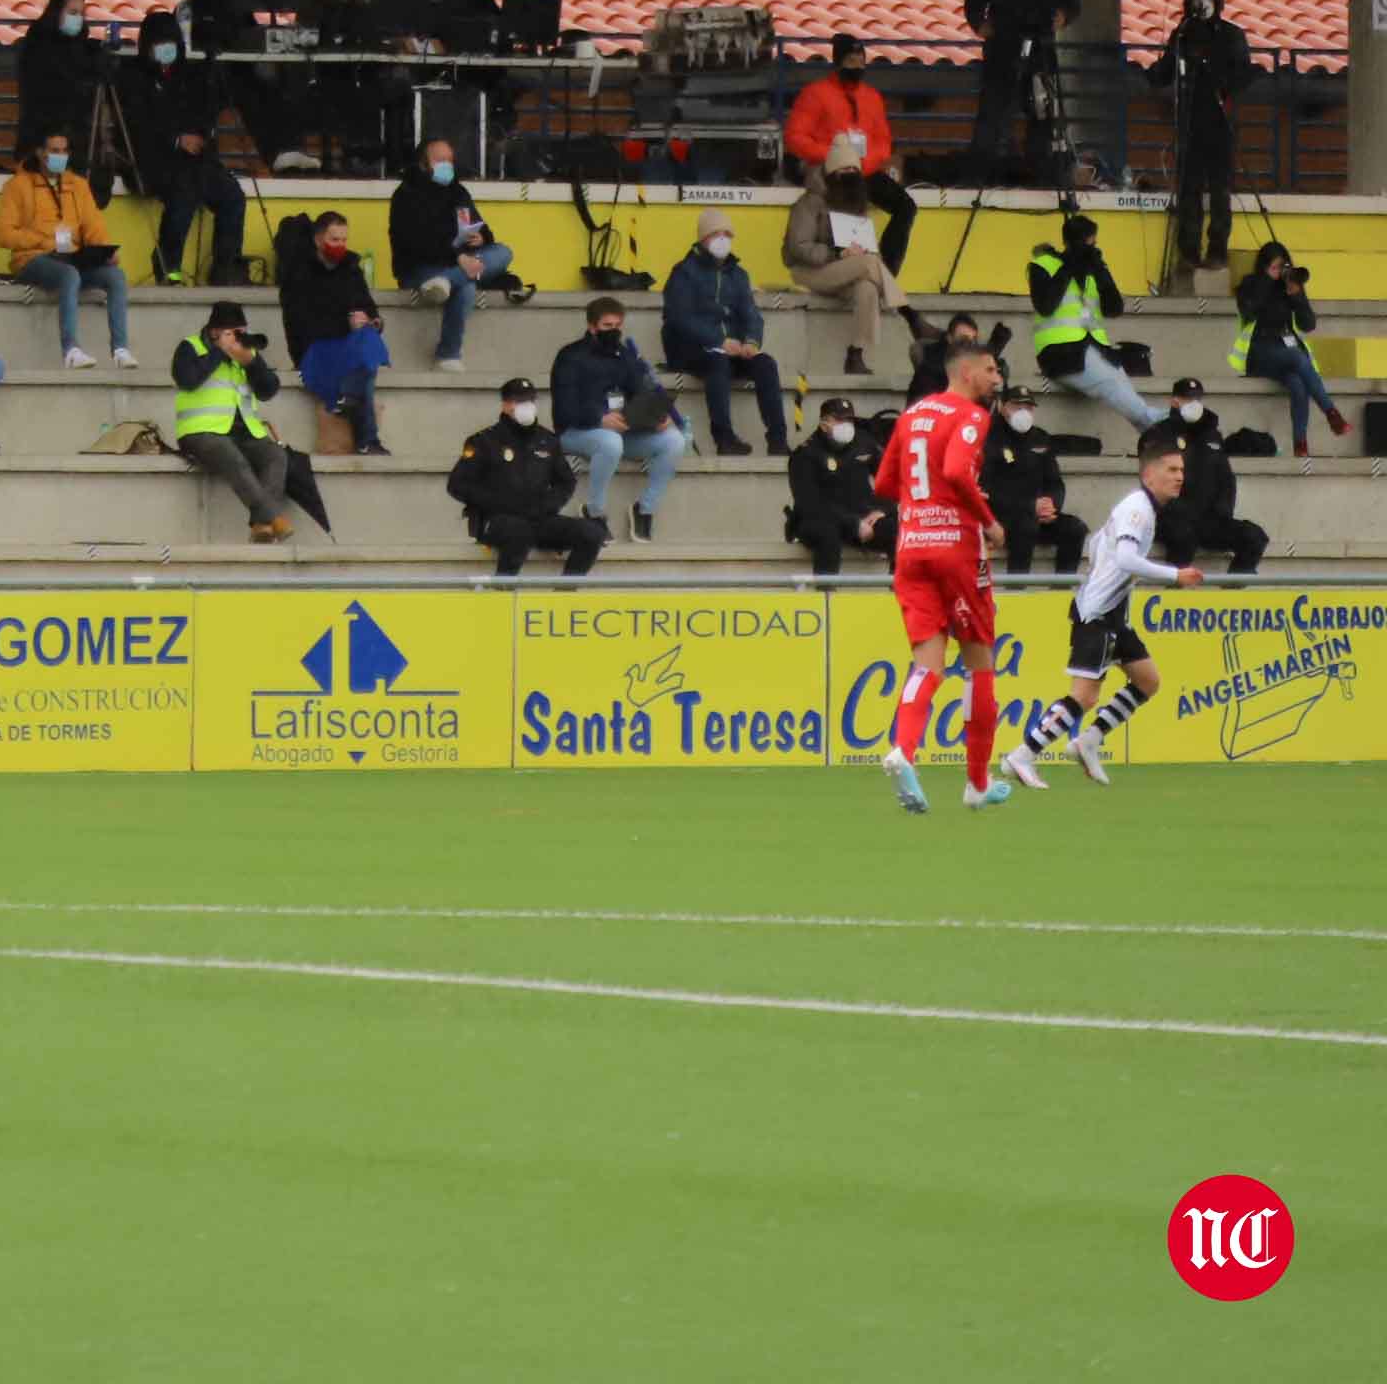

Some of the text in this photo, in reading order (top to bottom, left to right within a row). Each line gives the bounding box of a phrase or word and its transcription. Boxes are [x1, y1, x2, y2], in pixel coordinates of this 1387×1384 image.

[739, 191, 753, 200] TV
[1118, 197, 1170, 207] DIRECTIV
[909, 437, 931, 500] 3
[523, 610, 824, 638] ELECTRICIDAD
[1292, 594, 1387, 631] CARBAJO
[1178, 633, 1352, 721] ÁNGEL MARTÍN
[9, 723, 32, 742] DE
[37, 722, 113, 741] TORMES
[251, 698, 460, 739] Lafisconta
[521, 690, 823, 757] Santa Teresa
[251, 743, 335, 766] Abogado
